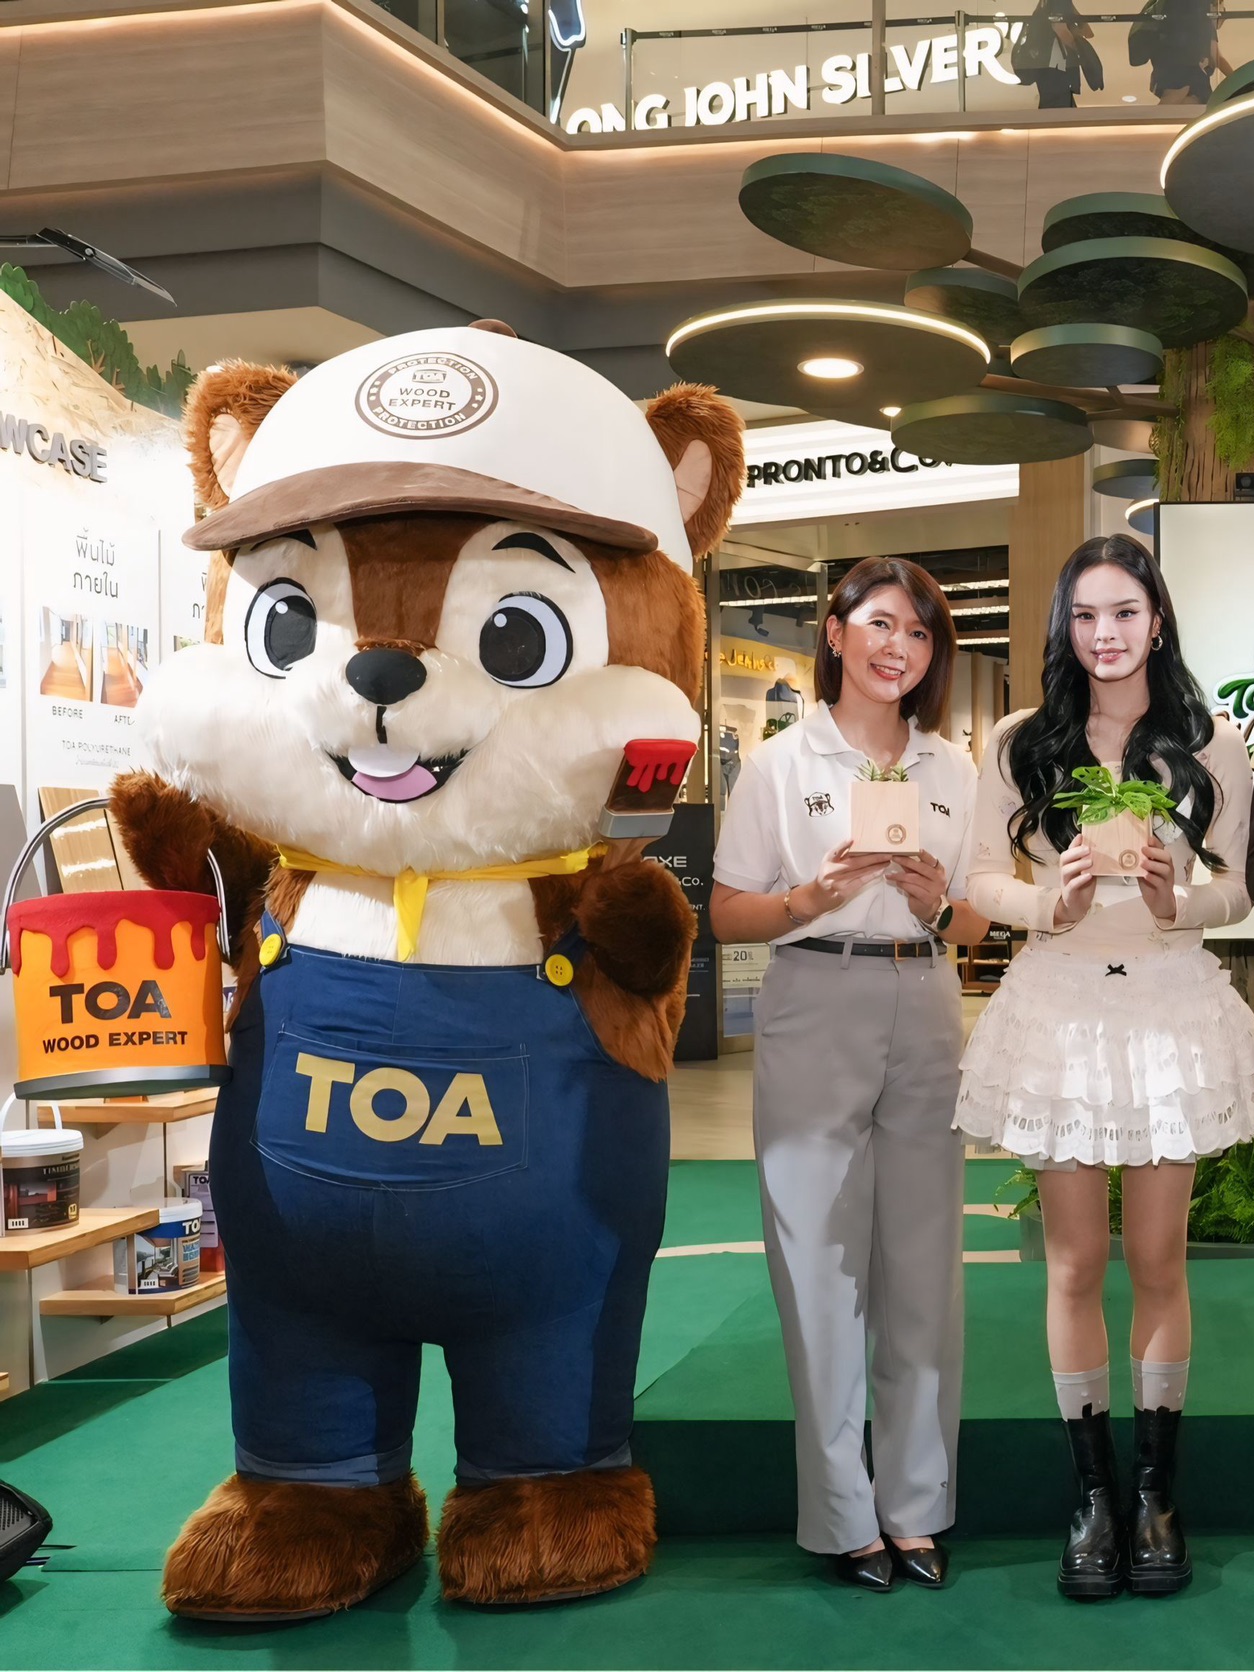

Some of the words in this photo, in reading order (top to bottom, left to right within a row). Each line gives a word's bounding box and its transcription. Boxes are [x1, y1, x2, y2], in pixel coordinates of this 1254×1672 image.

[684, 65, 808, 127] JOHN
[388, 398, 457, 411] EXPERT
[400, 387, 450, 399] WOOD
[372, 406, 466, 430] PROTECTION
[52, 705, 83, 719] BEFORE
[49, 980, 172, 1024] TOA
[42, 1034, 99, 1054] WOOD
[108, 1031, 188, 1047] EXPERT
[295, 1052, 503, 1146] TOA
